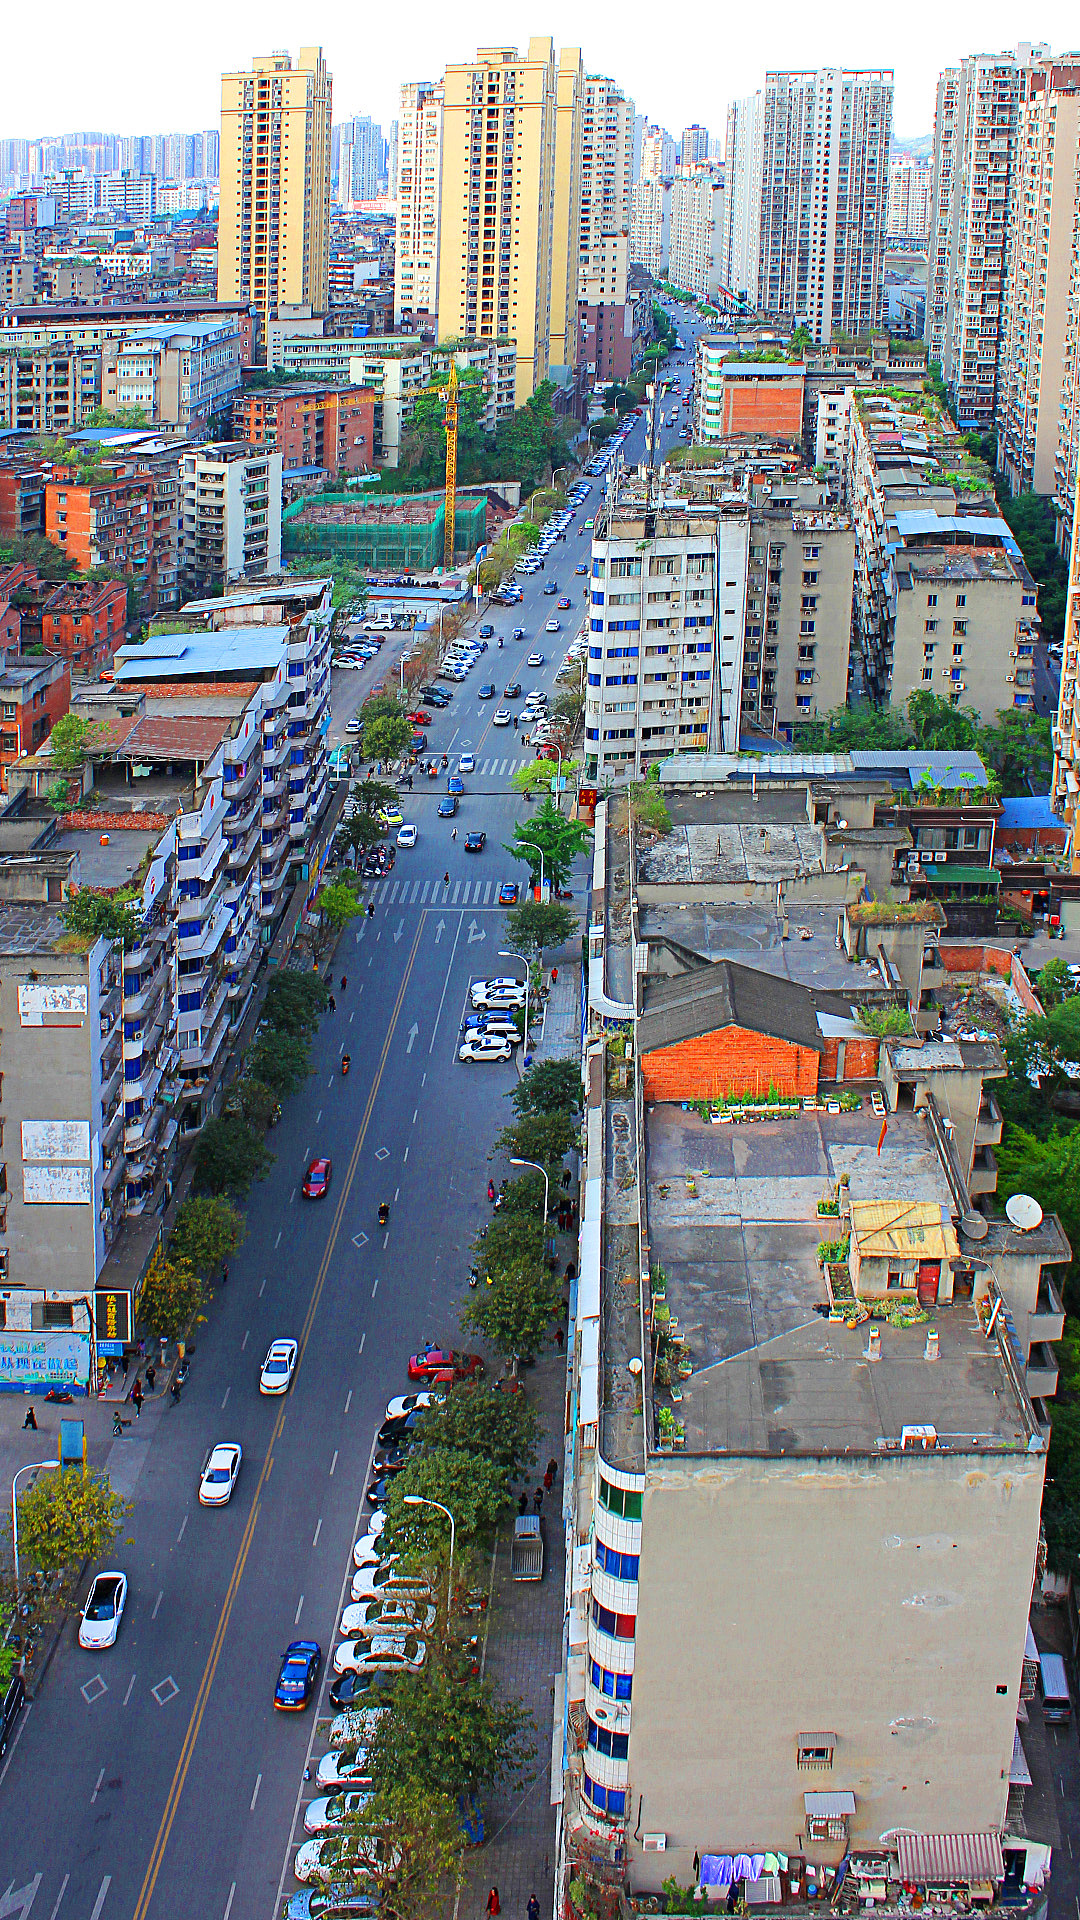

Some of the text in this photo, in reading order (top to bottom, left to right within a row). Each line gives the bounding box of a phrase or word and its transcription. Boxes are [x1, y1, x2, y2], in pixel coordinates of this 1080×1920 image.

[1, 1357, 78, 1370] 从现在做起
